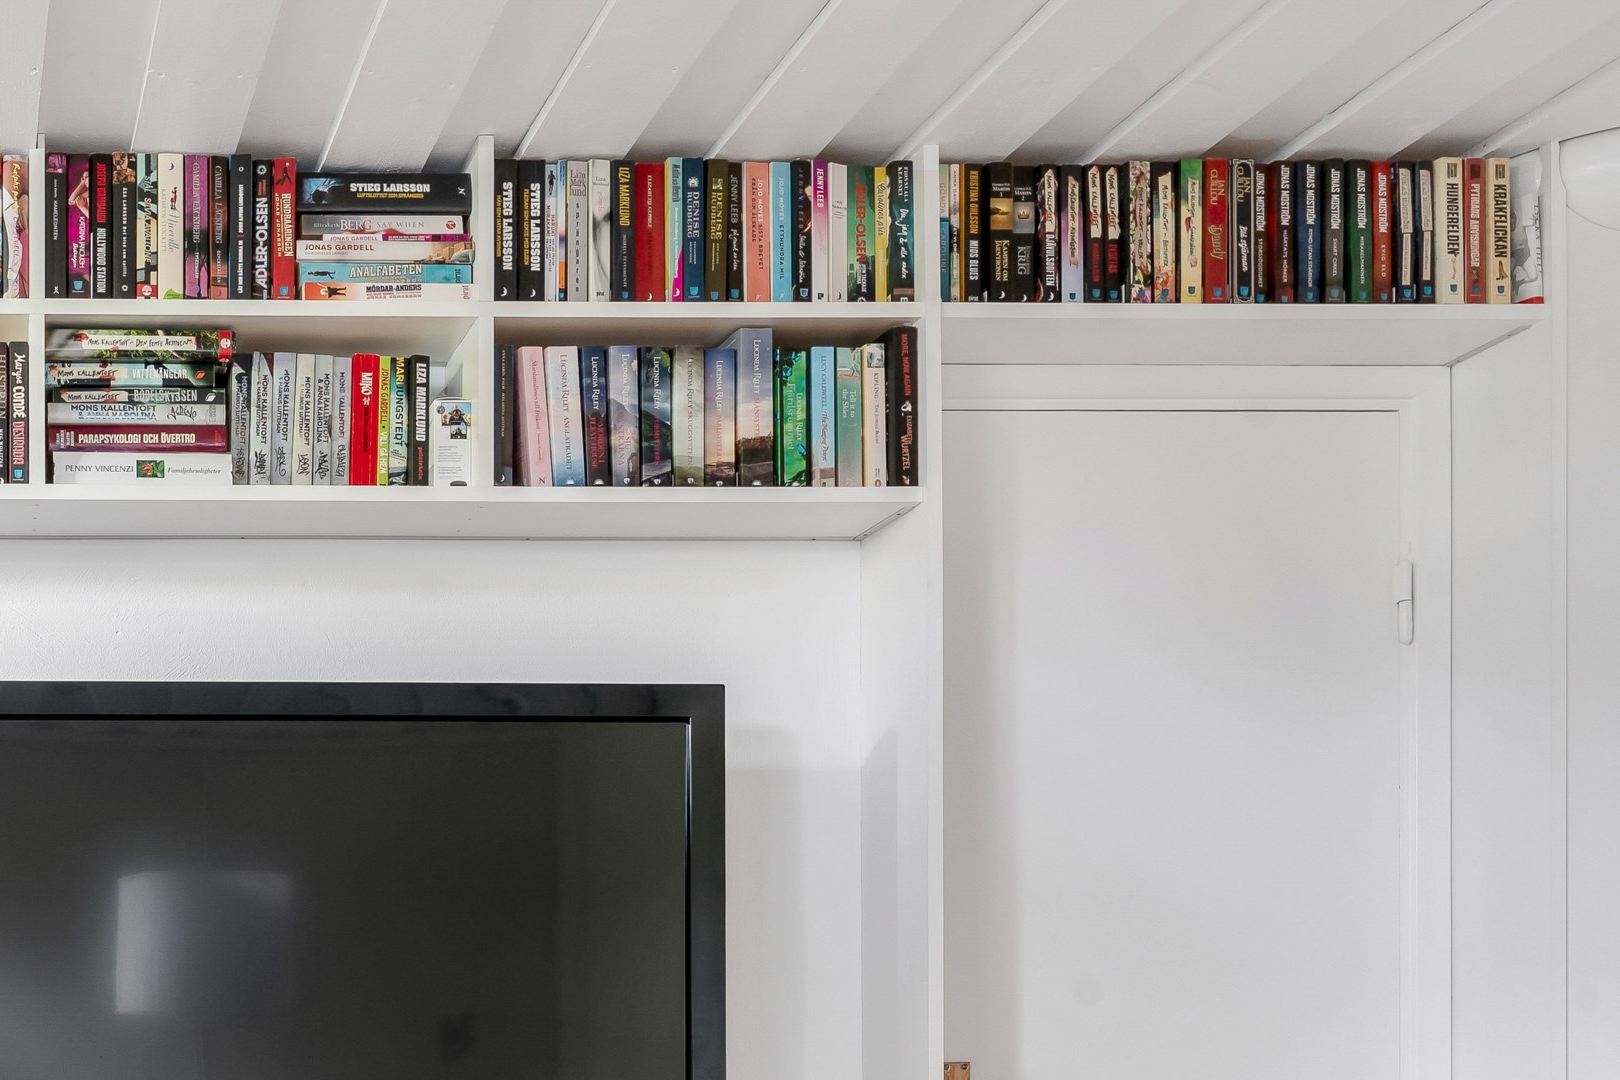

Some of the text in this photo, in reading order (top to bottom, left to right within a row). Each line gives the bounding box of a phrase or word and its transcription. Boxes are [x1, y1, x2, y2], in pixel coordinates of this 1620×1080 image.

[349, 182, 431, 193] STIEG LARSSON
[618, 167, 631, 227] LIZA MARKLUND
[1255, 170, 1266, 232] JONAS MOSTRÖM
[281, 193, 295, 258] HUNDRAÅRINGEN
[339, 218, 373, 231] BERG
[395, 221, 426, 229] WHEN
[529, 182, 541, 272] STIEG LARSSON
[686, 191, 694, 239] RUDBERG
[692, 191, 700, 239] DENISE
[969, 169, 979, 281] KRISTINA OHLSSON MIOS BLUES
[1446, 182, 1459, 255] HUNGERELDEN
[1493, 183, 1508, 258] KRÅKFLICKAN
[96, 227, 107, 294] HOLLYWOOD STATION
[255, 197, 268, 289] ADLER-OLSEN
[304, 243, 375, 252] JONAS GARDELL
[349, 263, 423, 278] ANALFABETEN
[11, 352, 26, 385] Maryse
[752, 339, 762, 395] LUCINDA RILEY
[12, 385, 27, 419] CONDÉ
[393, 384, 405, 448] JUNGSTEDT
[414, 362, 427, 442] LIZA MARKLUND
[12, 421, 25, 466] DESIRADA
[77, 433, 142, 444] PARAPSYKOLOGI
[142, 433, 159, 444] OCH
[160, 431, 196, 444] ÖVERTRO
[64, 464, 134, 473] PENNY VINCENZI
